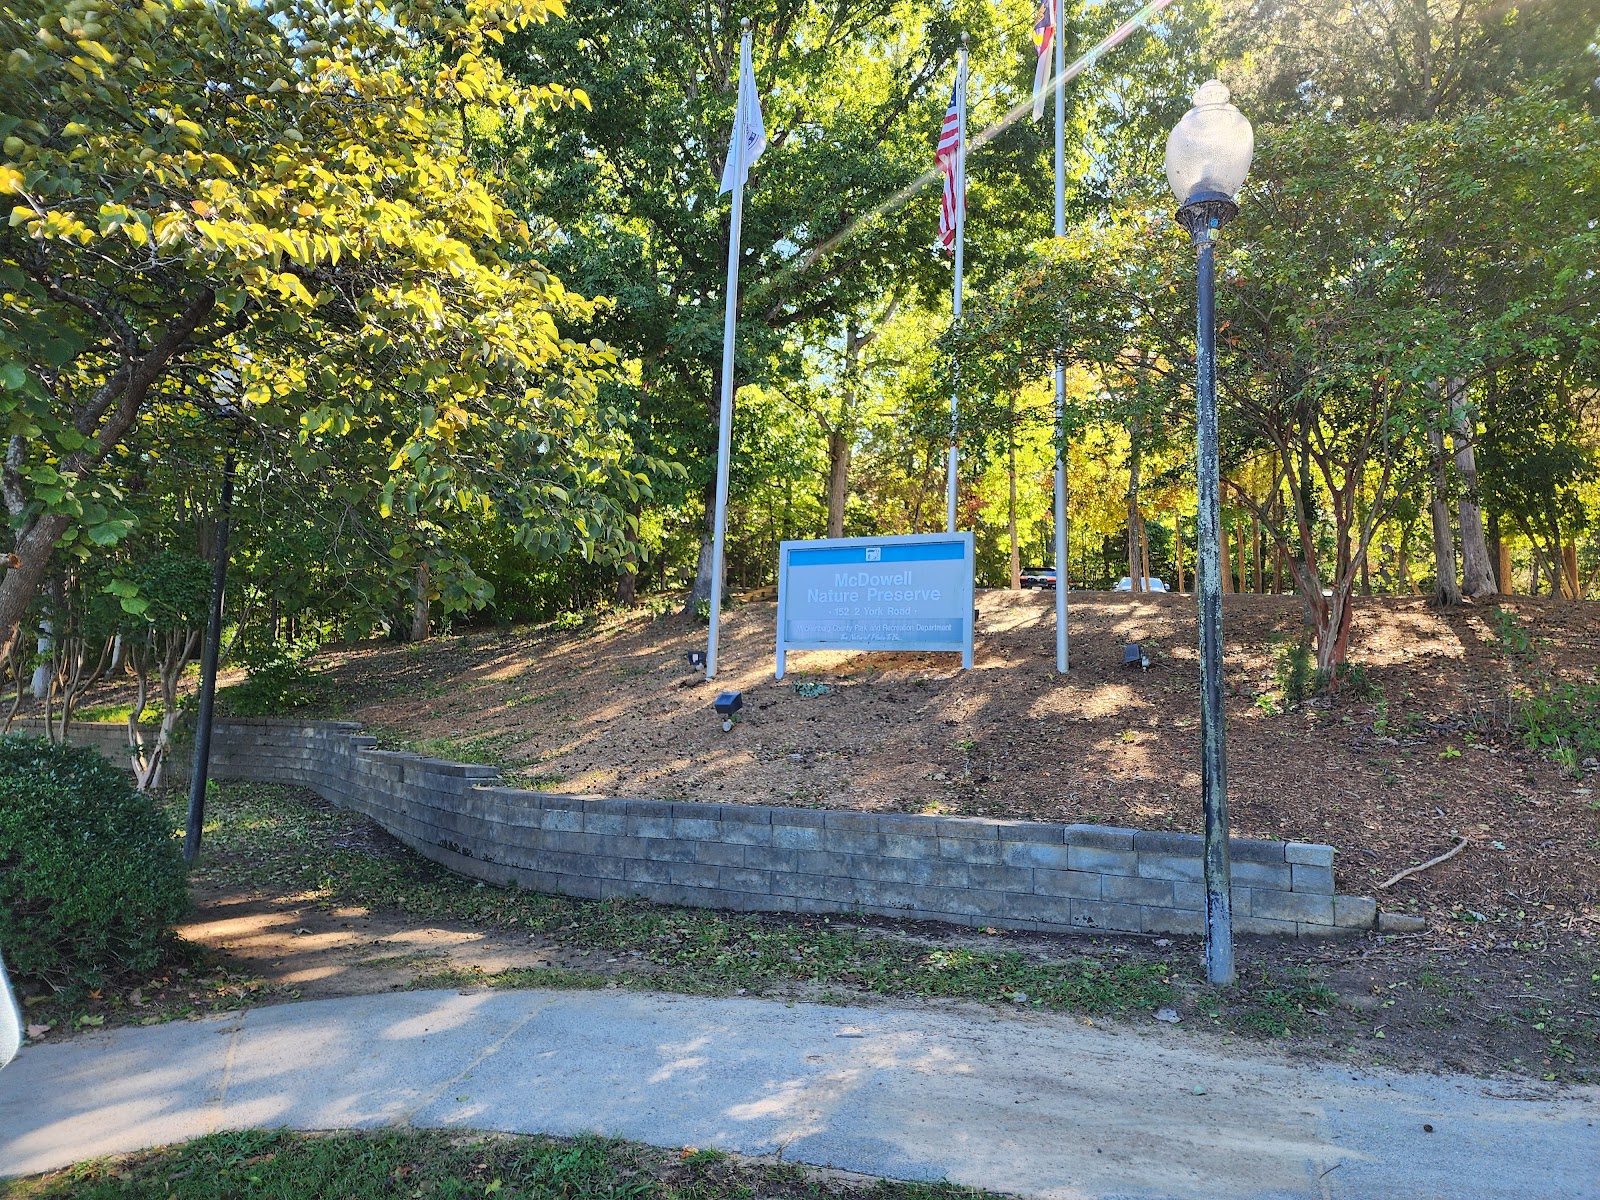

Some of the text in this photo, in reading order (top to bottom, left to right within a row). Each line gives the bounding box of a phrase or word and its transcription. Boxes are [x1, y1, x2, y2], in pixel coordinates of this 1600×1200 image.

[835, 571, 912, 587] McDowell
[807, 587, 941, 603] Nature Preserve
[864, 606, 884, 616] York
[887, 606, 911, 616] Road
[832, 624, 853, 633] County
[855, 624, 867, 632] Park
[882, 623, 913, 631] Recreation
[916, 623, 952, 632] Department
